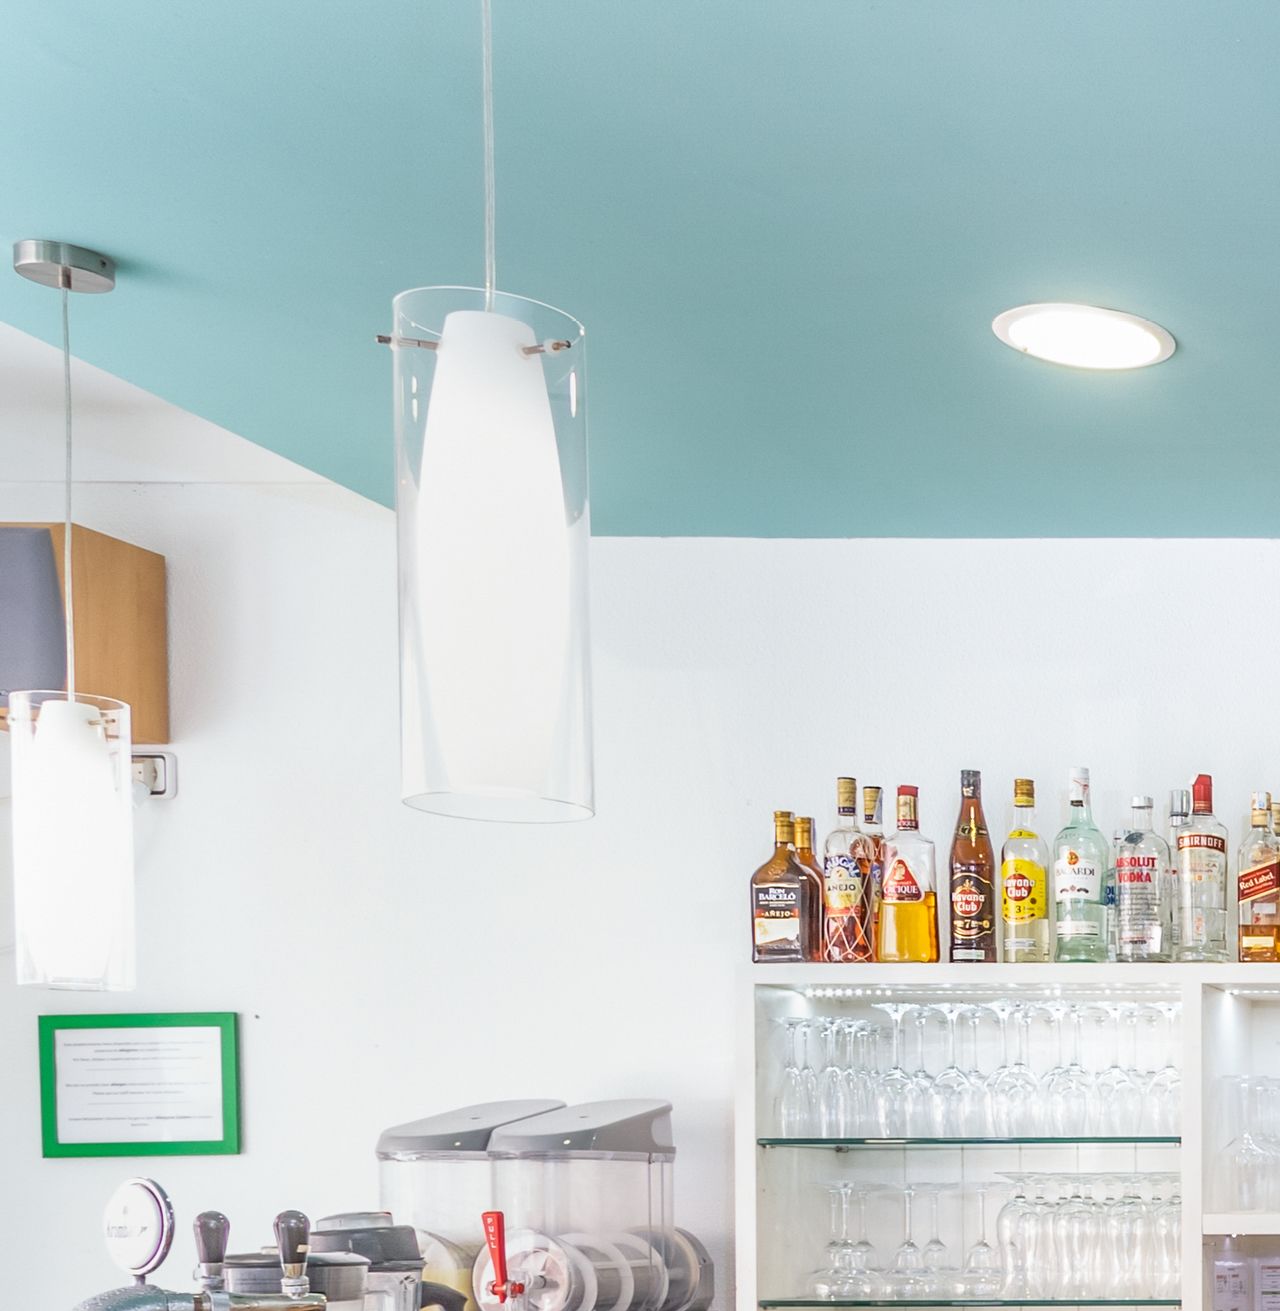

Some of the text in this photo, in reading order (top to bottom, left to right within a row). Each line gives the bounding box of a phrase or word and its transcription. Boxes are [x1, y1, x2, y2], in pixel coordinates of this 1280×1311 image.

[1178, 837, 1223, 849] SMIRNOFF
[1116, 857, 1157, 868] ABSOLUT
[1117, 872, 1152, 883] VODKA
[1240, 872, 1274, 890] Red Label
[1008, 887, 1028, 898] Club
[957, 901, 978, 912] Club
[487, 1217, 497, 1249] PULL
